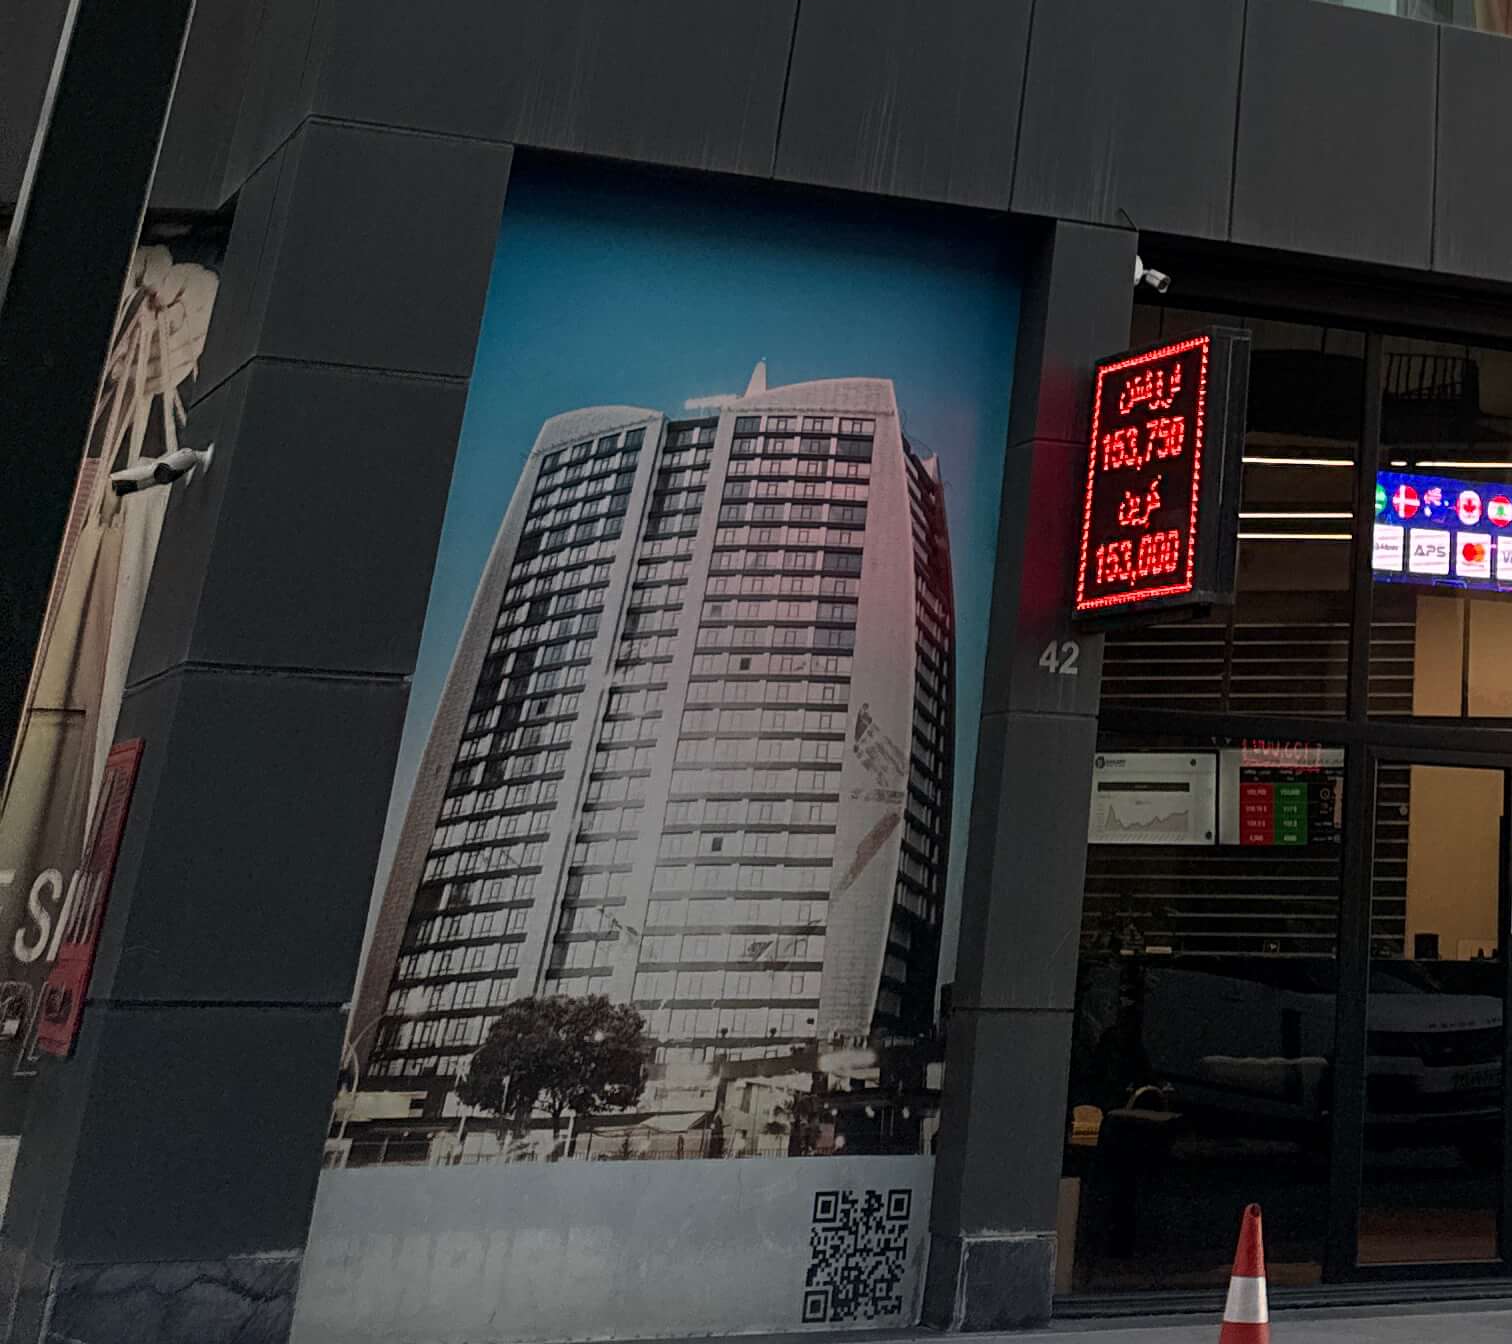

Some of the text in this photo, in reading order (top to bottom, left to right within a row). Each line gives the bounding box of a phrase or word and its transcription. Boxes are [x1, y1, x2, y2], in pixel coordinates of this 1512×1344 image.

[1103, 415, 1185, 471] 153,750
[1096, 529, 1180, 586] 153,000
[1414, 544, 1447, 558] APS
[1038, 640, 1080, 675] 42
